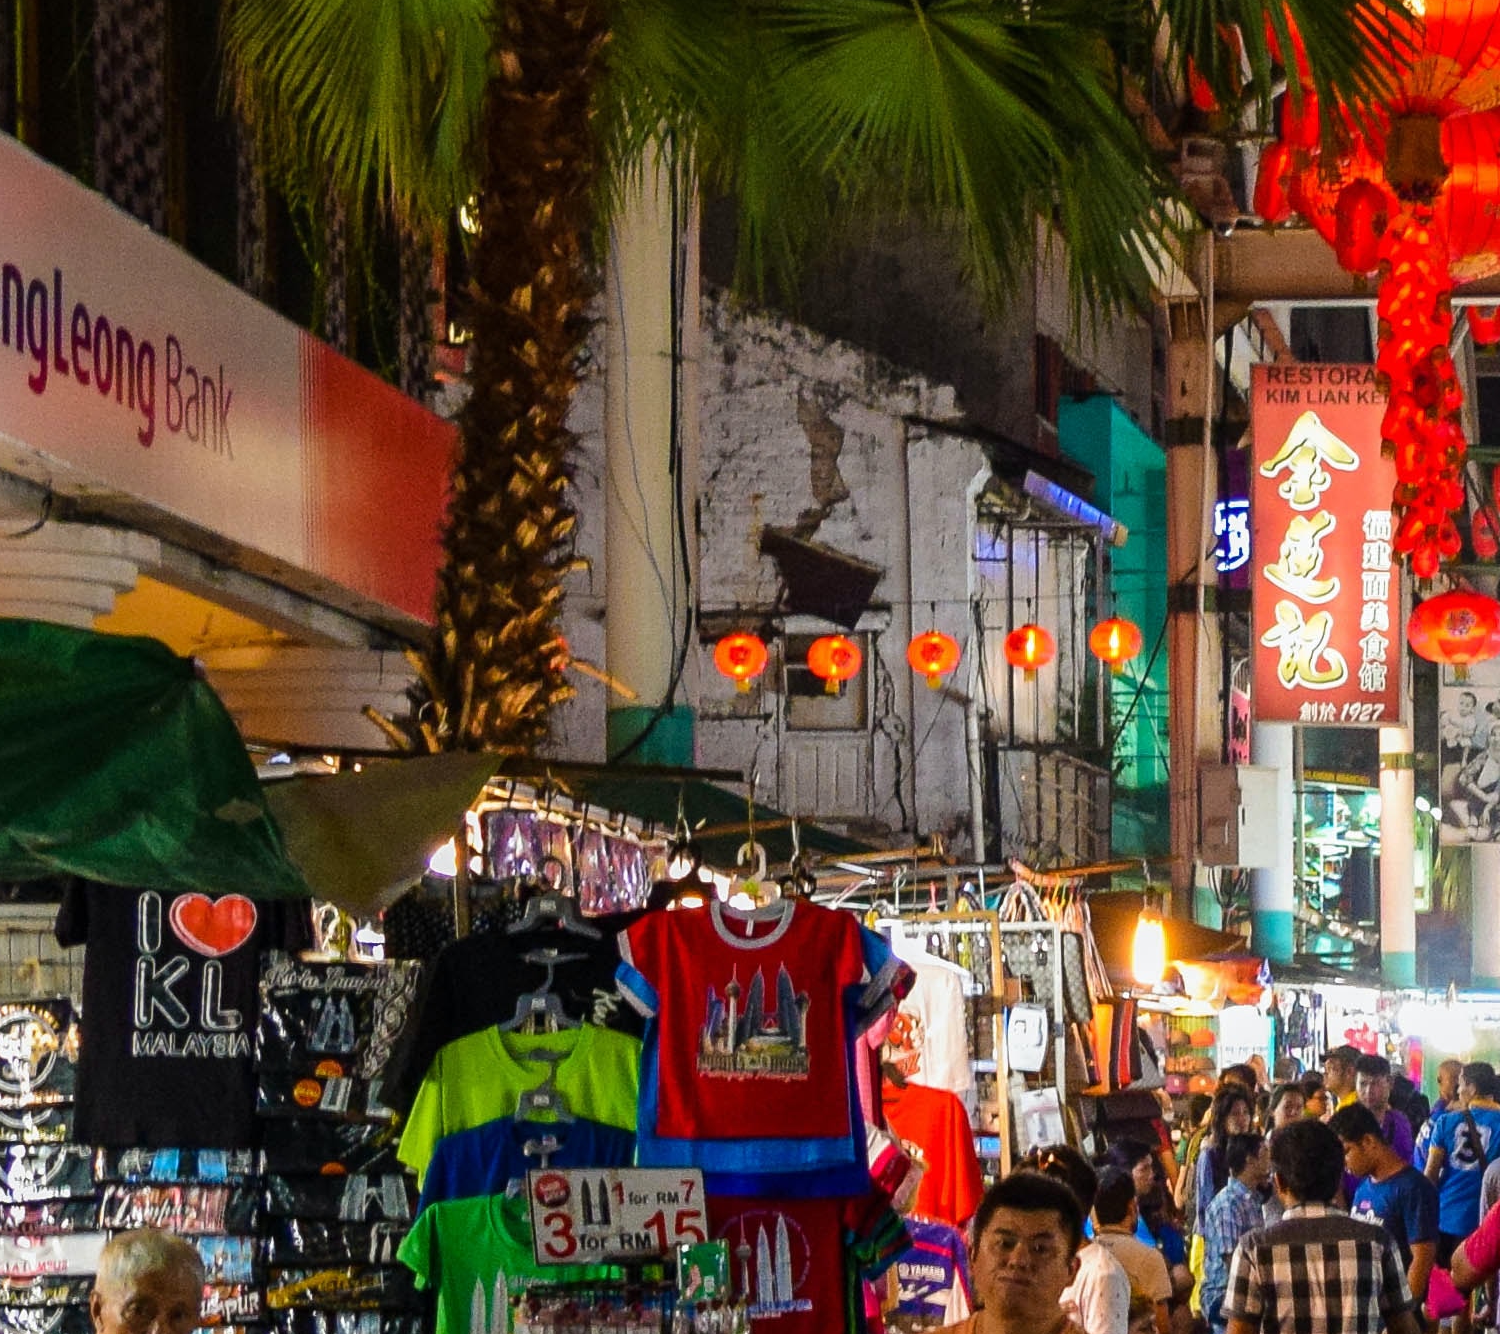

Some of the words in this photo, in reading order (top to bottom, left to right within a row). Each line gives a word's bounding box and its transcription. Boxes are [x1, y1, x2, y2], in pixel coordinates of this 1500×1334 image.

[1267, 368, 1377, 387] RESTORA
[166, 334, 234, 460] Bank
[1266, 391, 1299, 405] KIM
[1306, 391, 1350, 405] LIAN
[1340, 701, 1385, 724] 1927
[138, 890, 162, 955] I
[132, 1030, 251, 1058] MALAYSIA
[611, 1180, 625, 1205] 1
[628, 1192, 648, 1205] for
[543, 1210, 577, 1259] 3
[580, 1233, 607, 1251] for
[910, 1265, 945, 1283] YAMAHA
